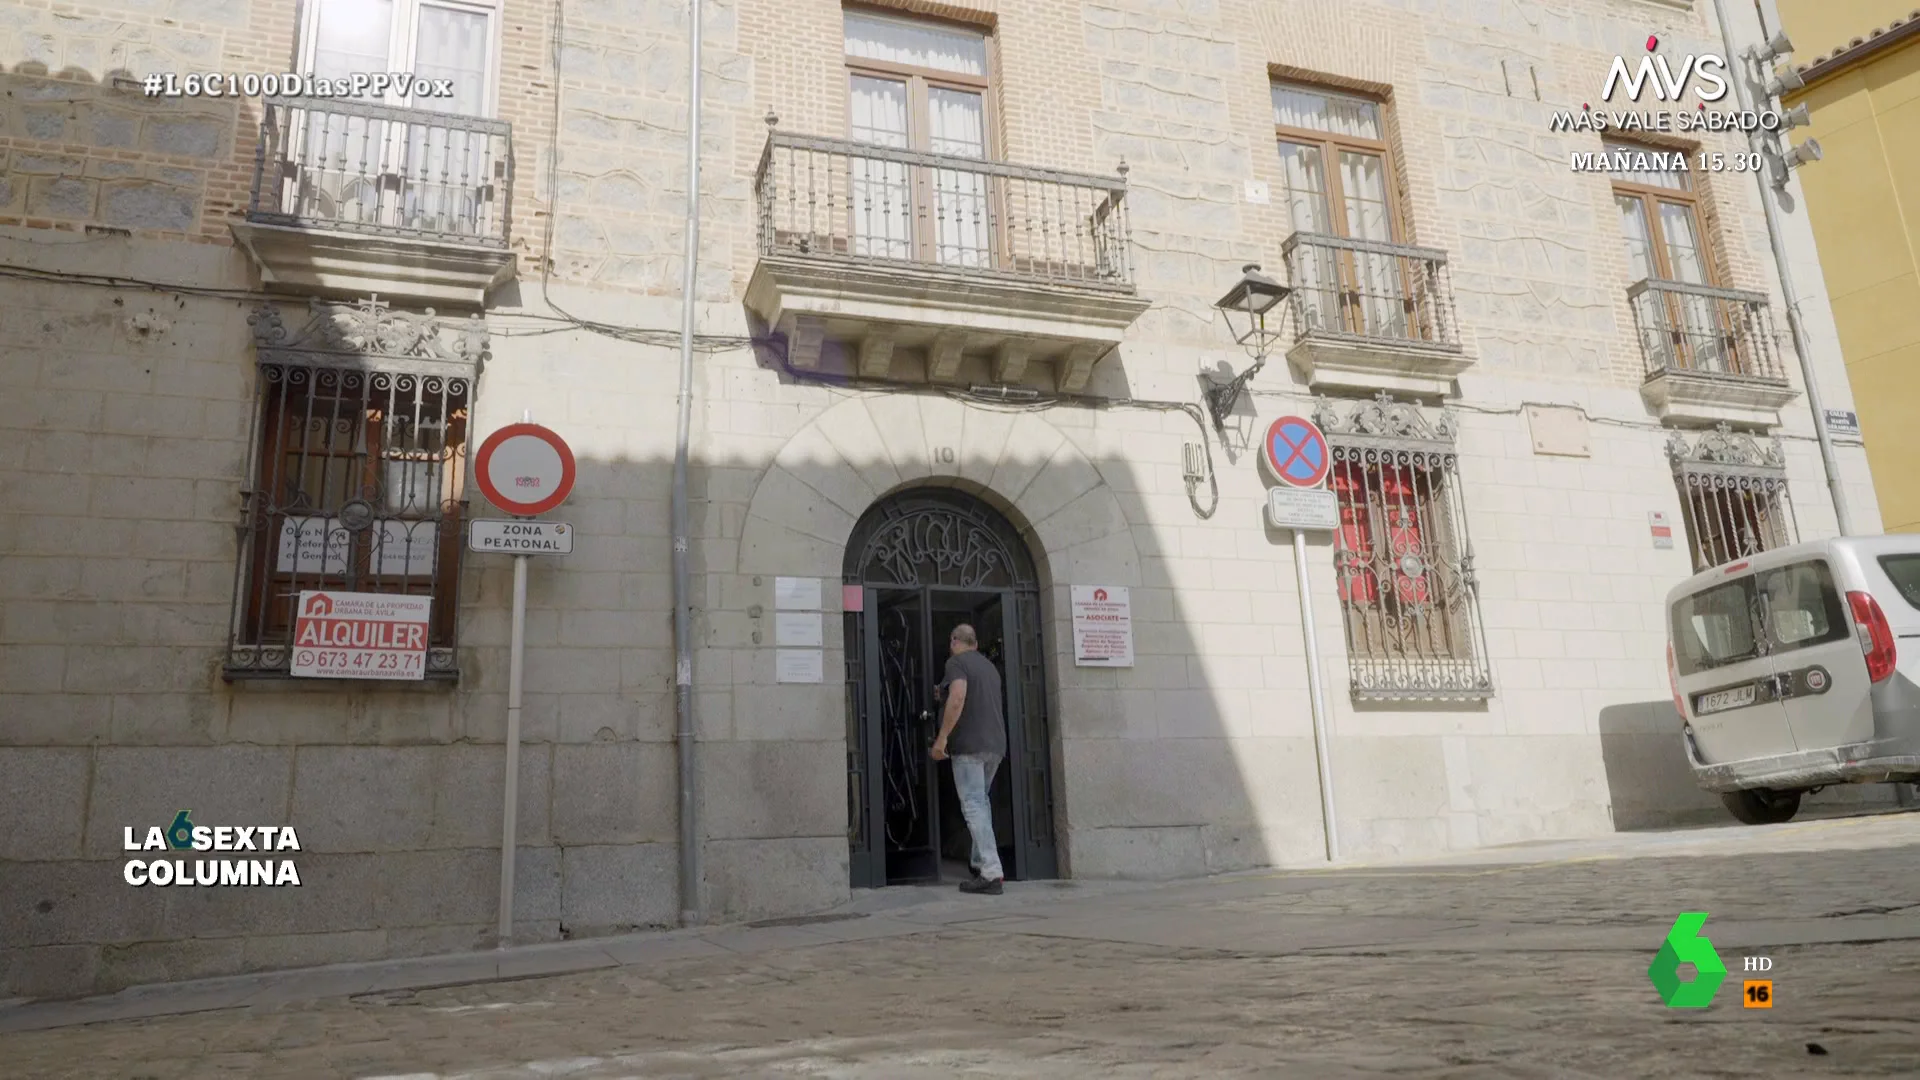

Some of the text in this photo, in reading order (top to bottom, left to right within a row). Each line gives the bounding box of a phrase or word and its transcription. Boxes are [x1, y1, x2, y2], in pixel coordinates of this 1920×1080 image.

[935, 448, 954, 464] 10
[503, 525, 542, 535] ZONA
[484, 538, 560, 549] PEATONAL
[387, 602, 424, 610] PROPIEDAD
[299, 620, 424, 648] ALQUILER
[318, 652, 421, 669] 673 47 23 71
[317, 668, 414, 677] www.camaraurbanaavila.es
[1705, 693, 1729, 708] 1672
